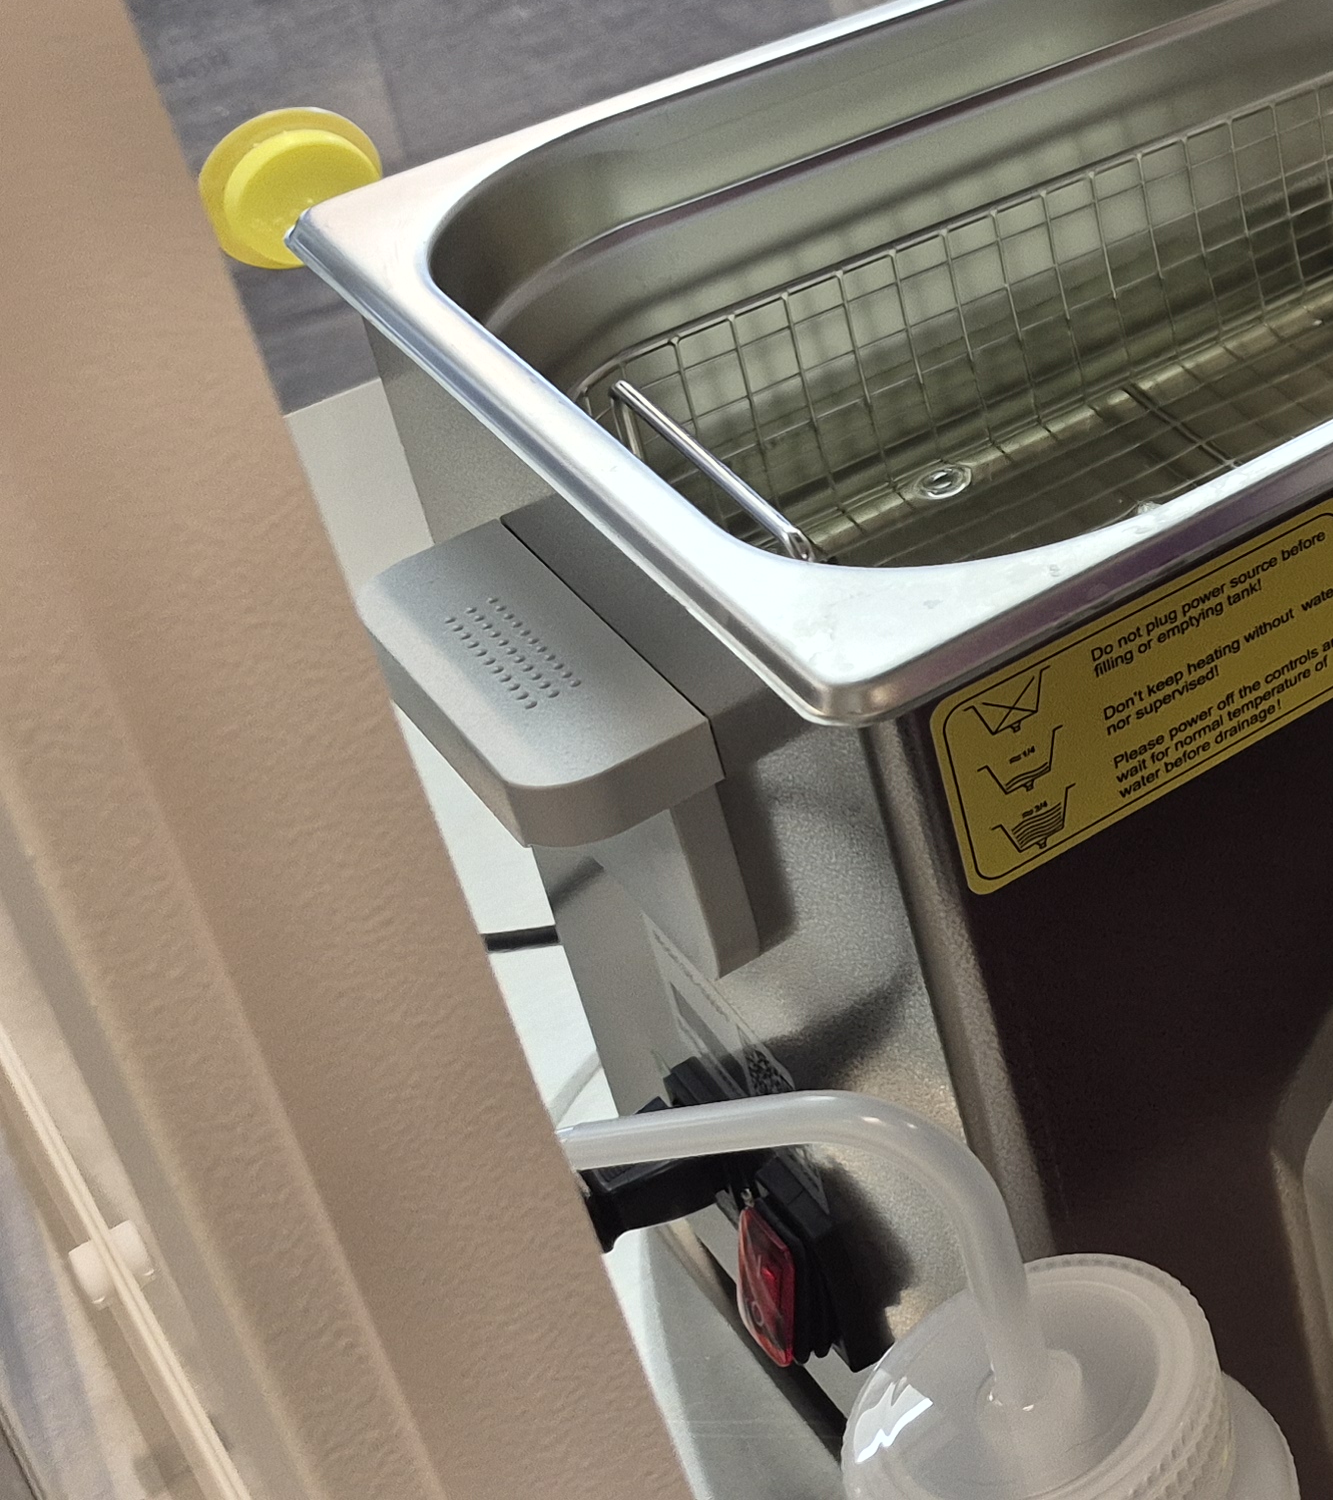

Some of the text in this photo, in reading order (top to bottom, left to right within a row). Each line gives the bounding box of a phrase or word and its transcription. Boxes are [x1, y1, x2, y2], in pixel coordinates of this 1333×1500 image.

[1090, 531, 1325, 662] Do not plug power source before
[1093, 577, 1261, 678] filling or emptying tank!
[1103, 689, 1144, 720] Don't
[1146, 670, 1183, 697] keep
[1186, 638, 1240, 675] heating
[1243, 607, 1294, 643] without
[1106, 664, 1219, 735] nor supervised!
[1113, 734, 1164, 769] Please
[1168, 705, 1213, 741] power
[1216, 690, 1234, 710] off
[1238, 680, 1260, 699] the
[1264, 647, 1319, 684] controls
[1115, 654, 1327, 782] wait for normal temperature of
[1118, 698, 1281, 798] water before drainage!
